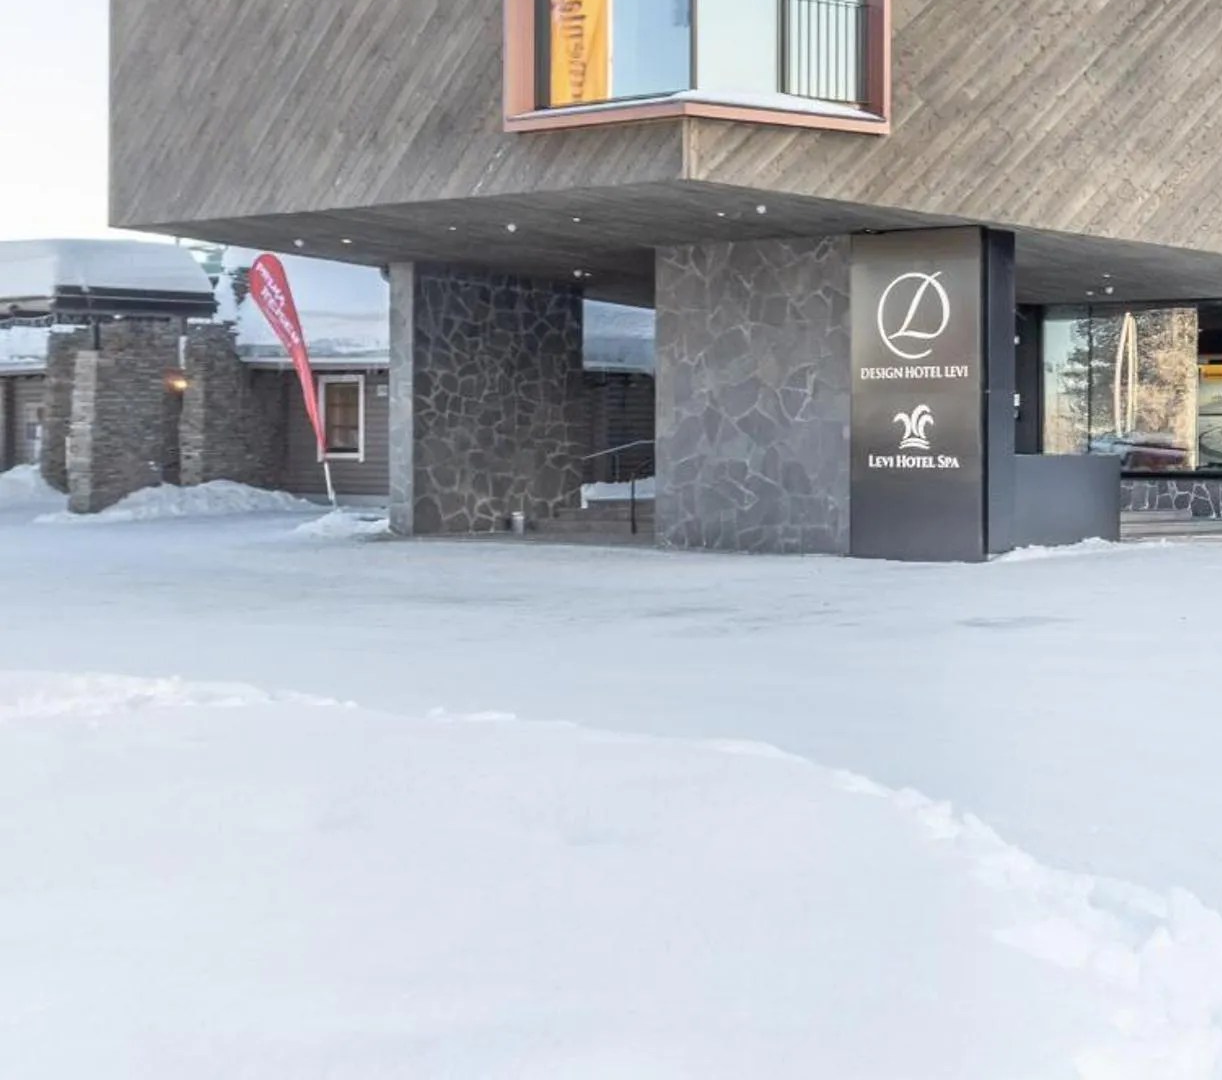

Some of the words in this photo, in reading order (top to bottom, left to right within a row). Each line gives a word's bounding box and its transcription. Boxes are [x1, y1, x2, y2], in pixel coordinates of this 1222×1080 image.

[860, 366, 904, 380] DESIGN
[905, 365, 942, 379] HOTEL
[944, 365, 969, 378] LEVI
[868, 454, 894, 468] LEVI
[896, 454, 936, 468] HOTEL
[937, 454, 960, 468] SPA
